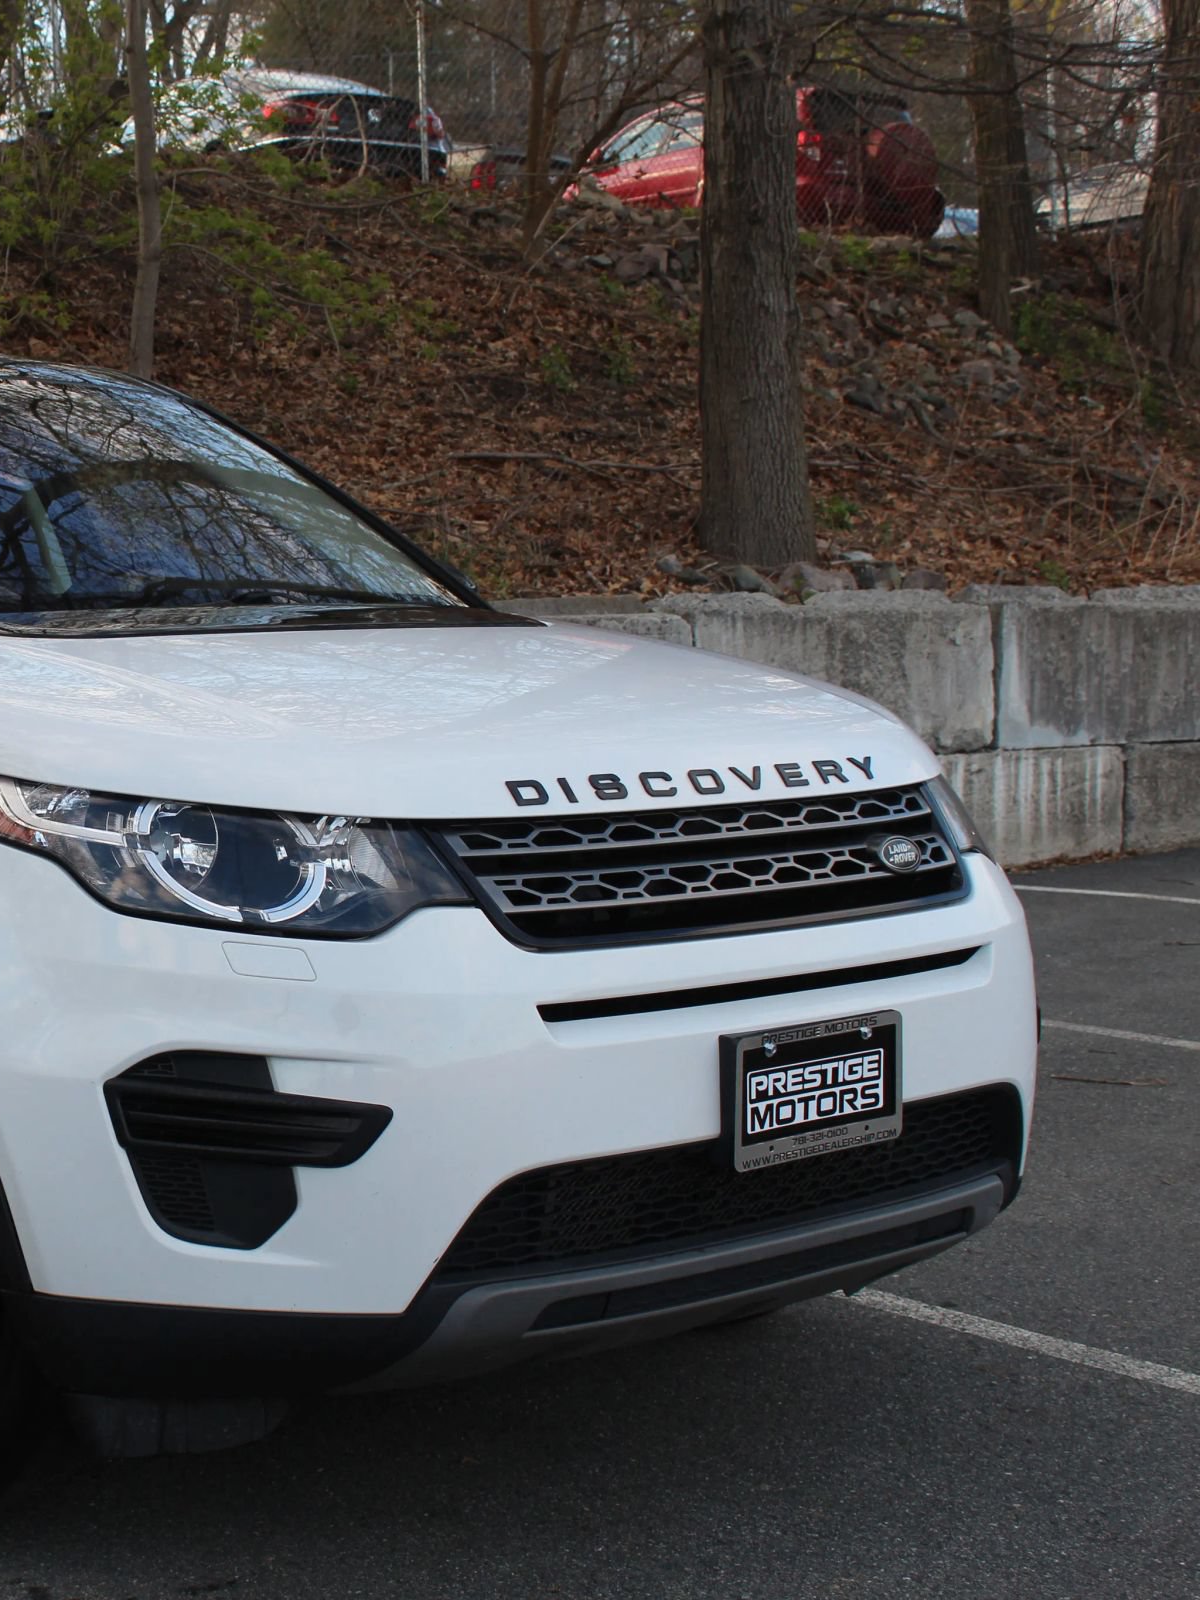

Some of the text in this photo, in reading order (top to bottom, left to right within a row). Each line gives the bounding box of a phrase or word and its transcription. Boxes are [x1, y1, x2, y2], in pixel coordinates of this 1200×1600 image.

[505, 756, 875, 807] DISCOVERY
[888, 843, 908, 854] LAND
[894, 852, 916, 864] ROVER
[761, 1015, 878, 1046] PRESTIGE MOTORS
[750, 1054, 880, 1099] PRESTIGE
[750, 1082, 880, 1132] MOTORS
[742, 1128, 897, 1169] WWW.PRESTIGEDEALERSHIP.COM
